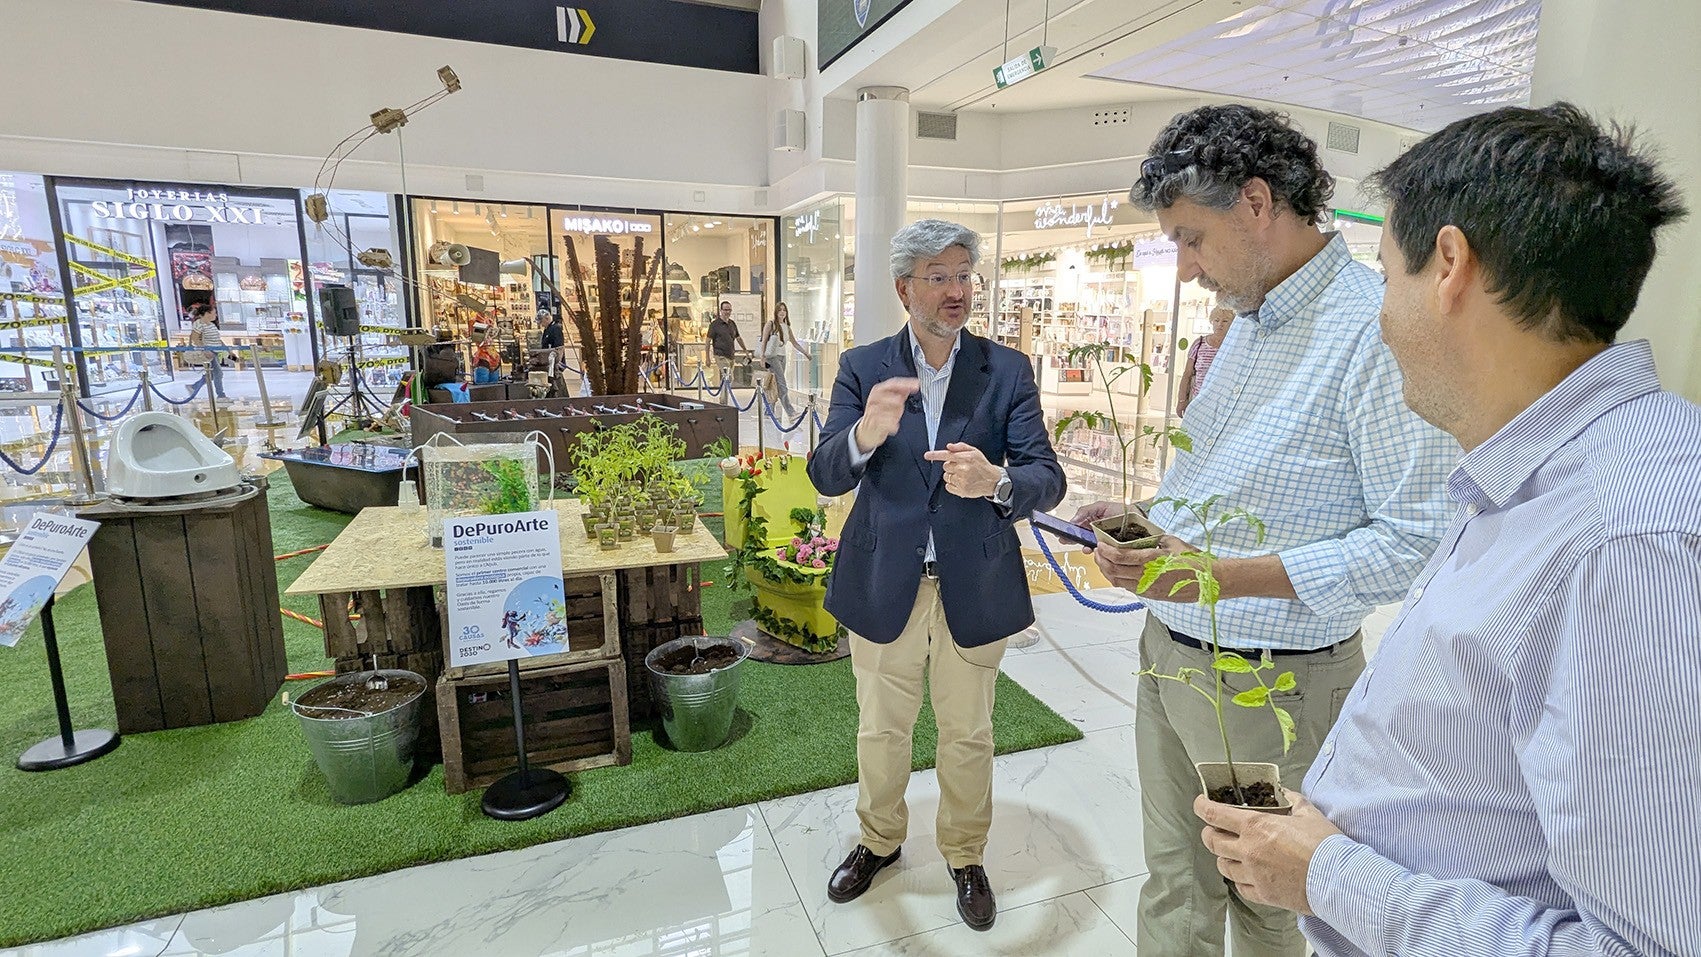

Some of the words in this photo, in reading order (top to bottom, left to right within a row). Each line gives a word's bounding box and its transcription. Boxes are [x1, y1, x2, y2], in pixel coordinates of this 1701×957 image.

[92, 200, 193, 220] SIGLO
[207, 205, 264, 225] XXI
[0, 320, 35, 330] 70%
[10, 356, 47, 367] 70%
[358, 360, 385, 369] 70%
[31, 518, 88, 538] DePuroArte
[453, 518, 549, 538] DePuroArte
[453, 536, 494, 546] sostenible
[463, 625, 480, 635] 30
[460, 643, 491, 653] DESTINO
